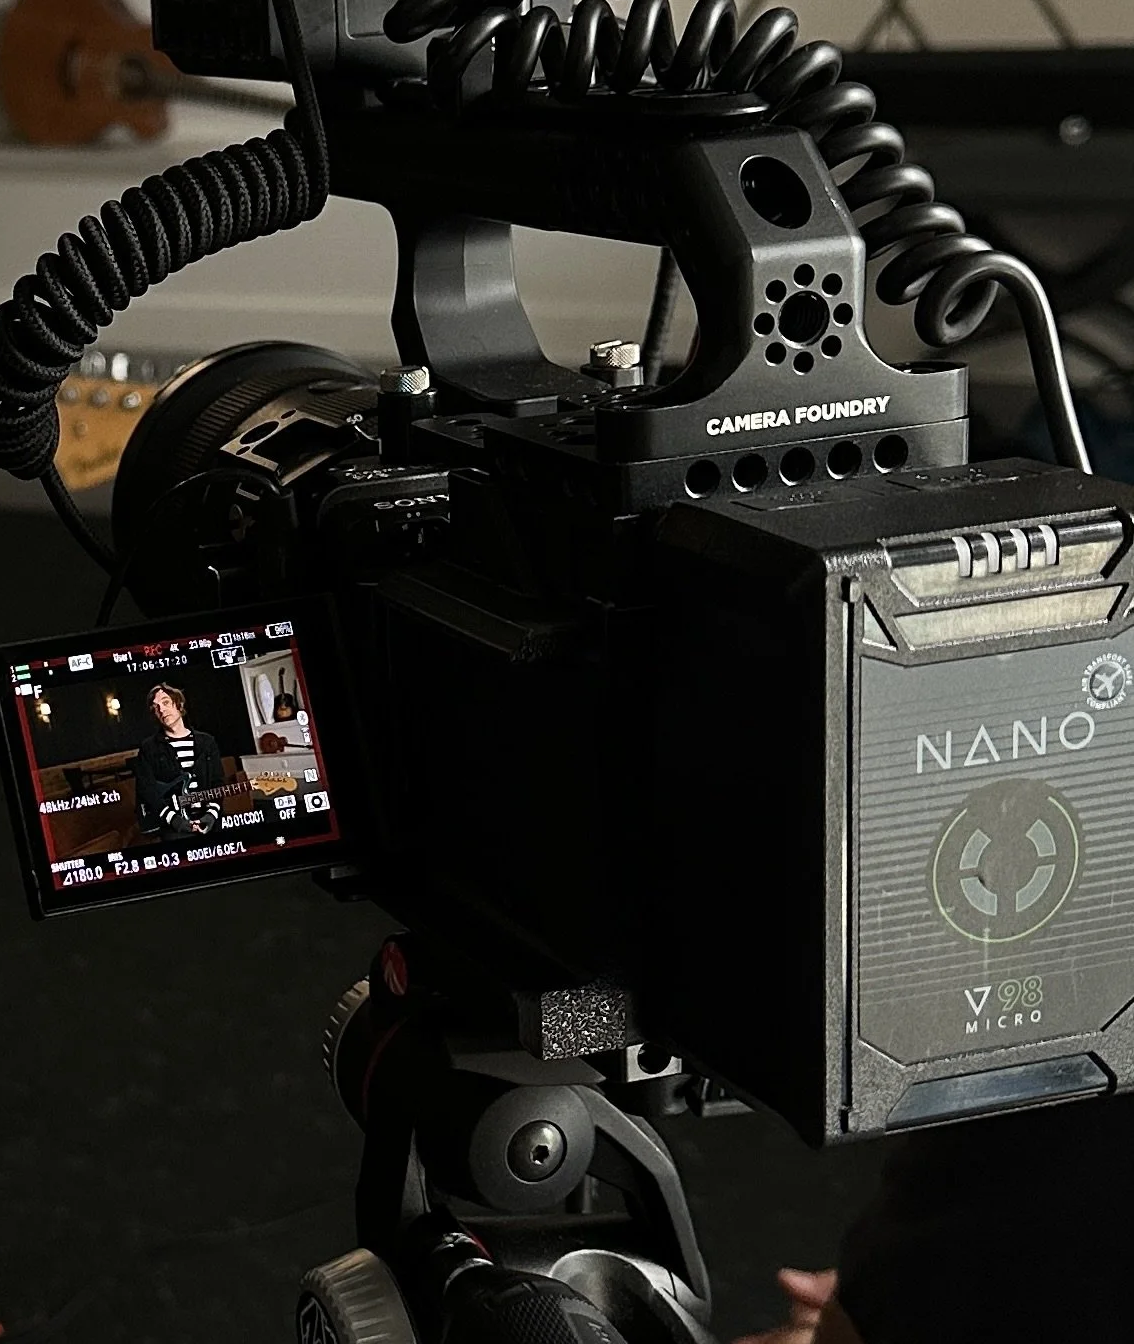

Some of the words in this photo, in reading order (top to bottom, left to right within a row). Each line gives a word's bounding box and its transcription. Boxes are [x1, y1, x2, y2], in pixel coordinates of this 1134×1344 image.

[706, 409, 791, 436] CAMERA
[795, 395, 891, 425] FOUNDRY
[126, 654, 188, 673] 17:06:57:20
[916, 711, 1096, 774] NANO
[279, 807, 296, 821] OFF
[114, 859, 140, 876] F2.8
[965, 1009, 1042, 1034] MICRO
